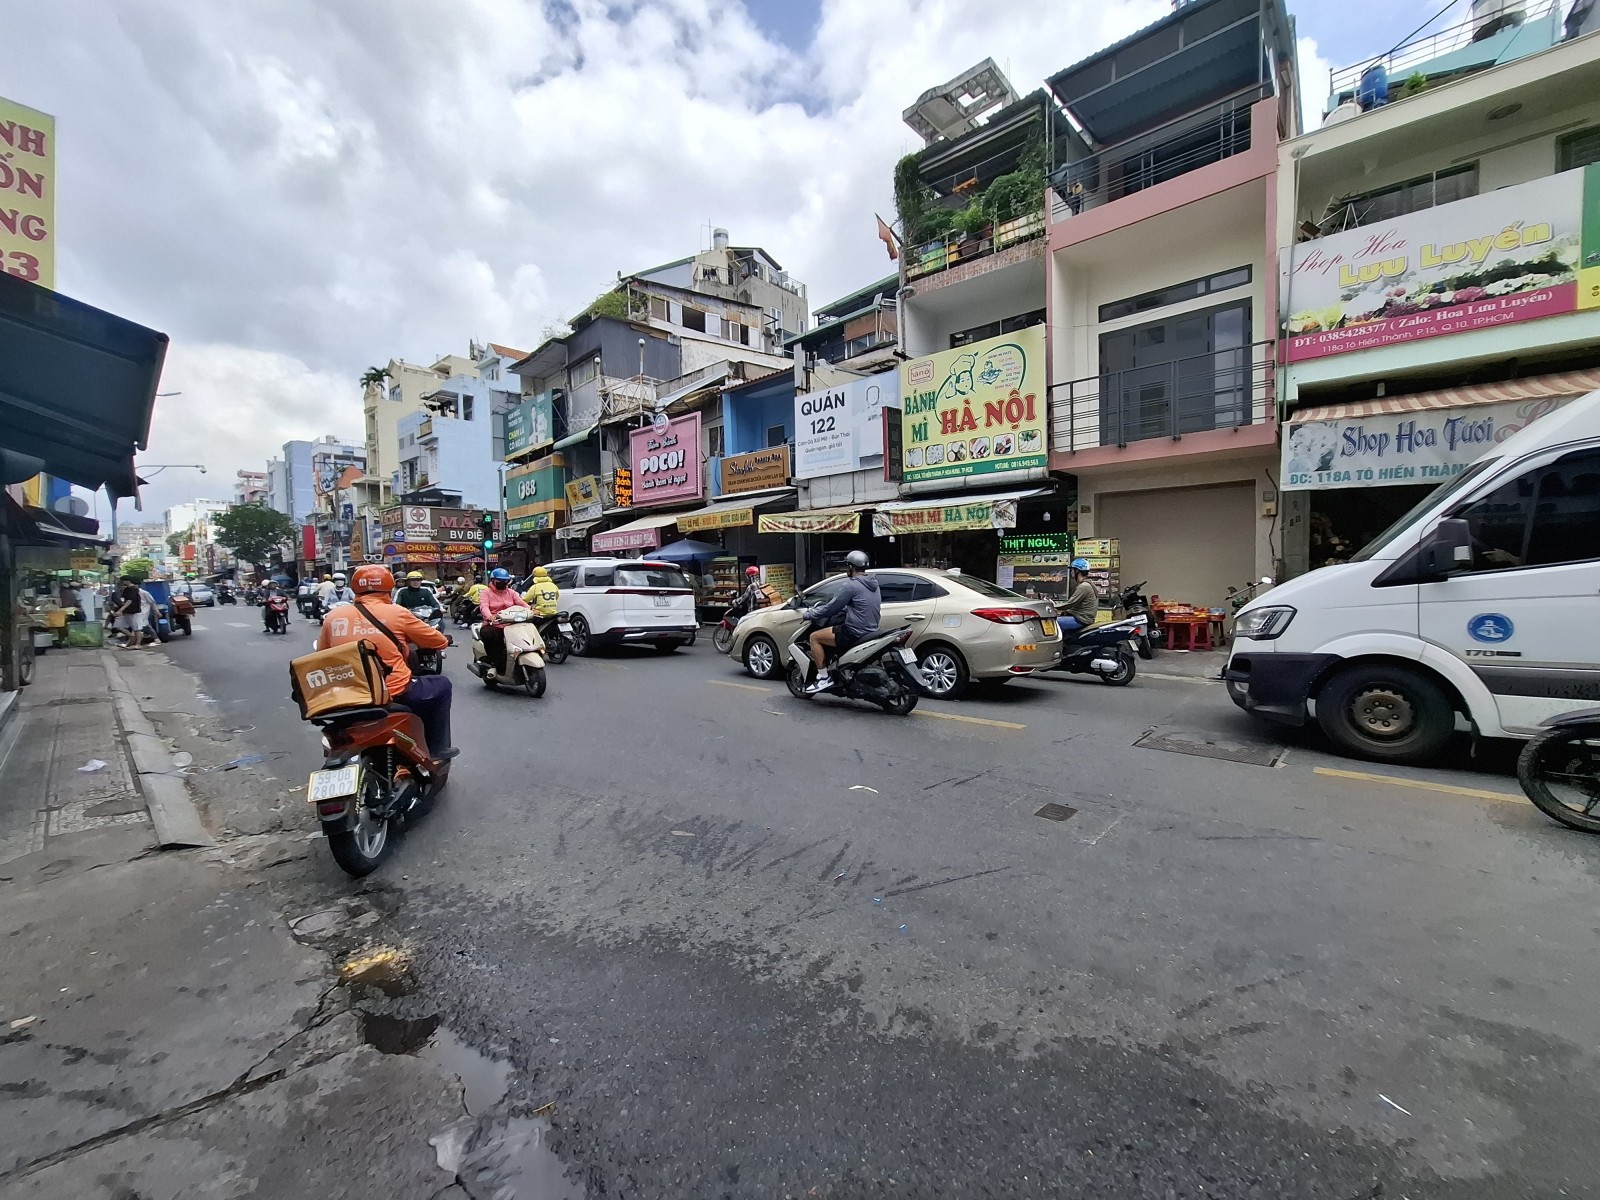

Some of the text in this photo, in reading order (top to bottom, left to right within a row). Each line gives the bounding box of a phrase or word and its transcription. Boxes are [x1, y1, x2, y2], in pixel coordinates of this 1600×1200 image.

[1283, 228, 1408, 276] Shop Hoa
[1339, 220, 1554, 288] Lưu Luyến
[1294, 335, 1316, 348] ĐT:
[1319, 322, 1387, 343] 0385428377
[1398, 313, 1432, 329] Zalo:
[1436, 310, 1463, 321] Hoa
[1468, 303, 1496, 315] Lưu
[1501, 290, 1553, 309] Luyến)
[1322, 344, 1344, 353] 118a
[801, 390, 845, 416] QUÁN
[904, 388, 937, 416] BÁNH
[810, 415, 835, 435] 122
[911, 389, 1036, 443] MÌ HÀ NỘI
[1340, 425, 1390, 457] Shop
[1396, 419, 1437, 454] Hoa
[1443, 415, 1495, 452] Tươi
[640, 449, 685, 475] POCO!
[1289, 474, 1313, 485] ĐC:
[1317, 470, 1351, 483] 118A
[1378, 462, 1415, 480] HIẾN
[450, 530, 463, 539] BV
[467, 528, 484, 541] ĐIỆ
[1003, 539, 1025, 550] THỊT
[540, 589, 556, 601] be
[328, 668, 356, 683] Food
[313, 780, 353, 800] 280.07
